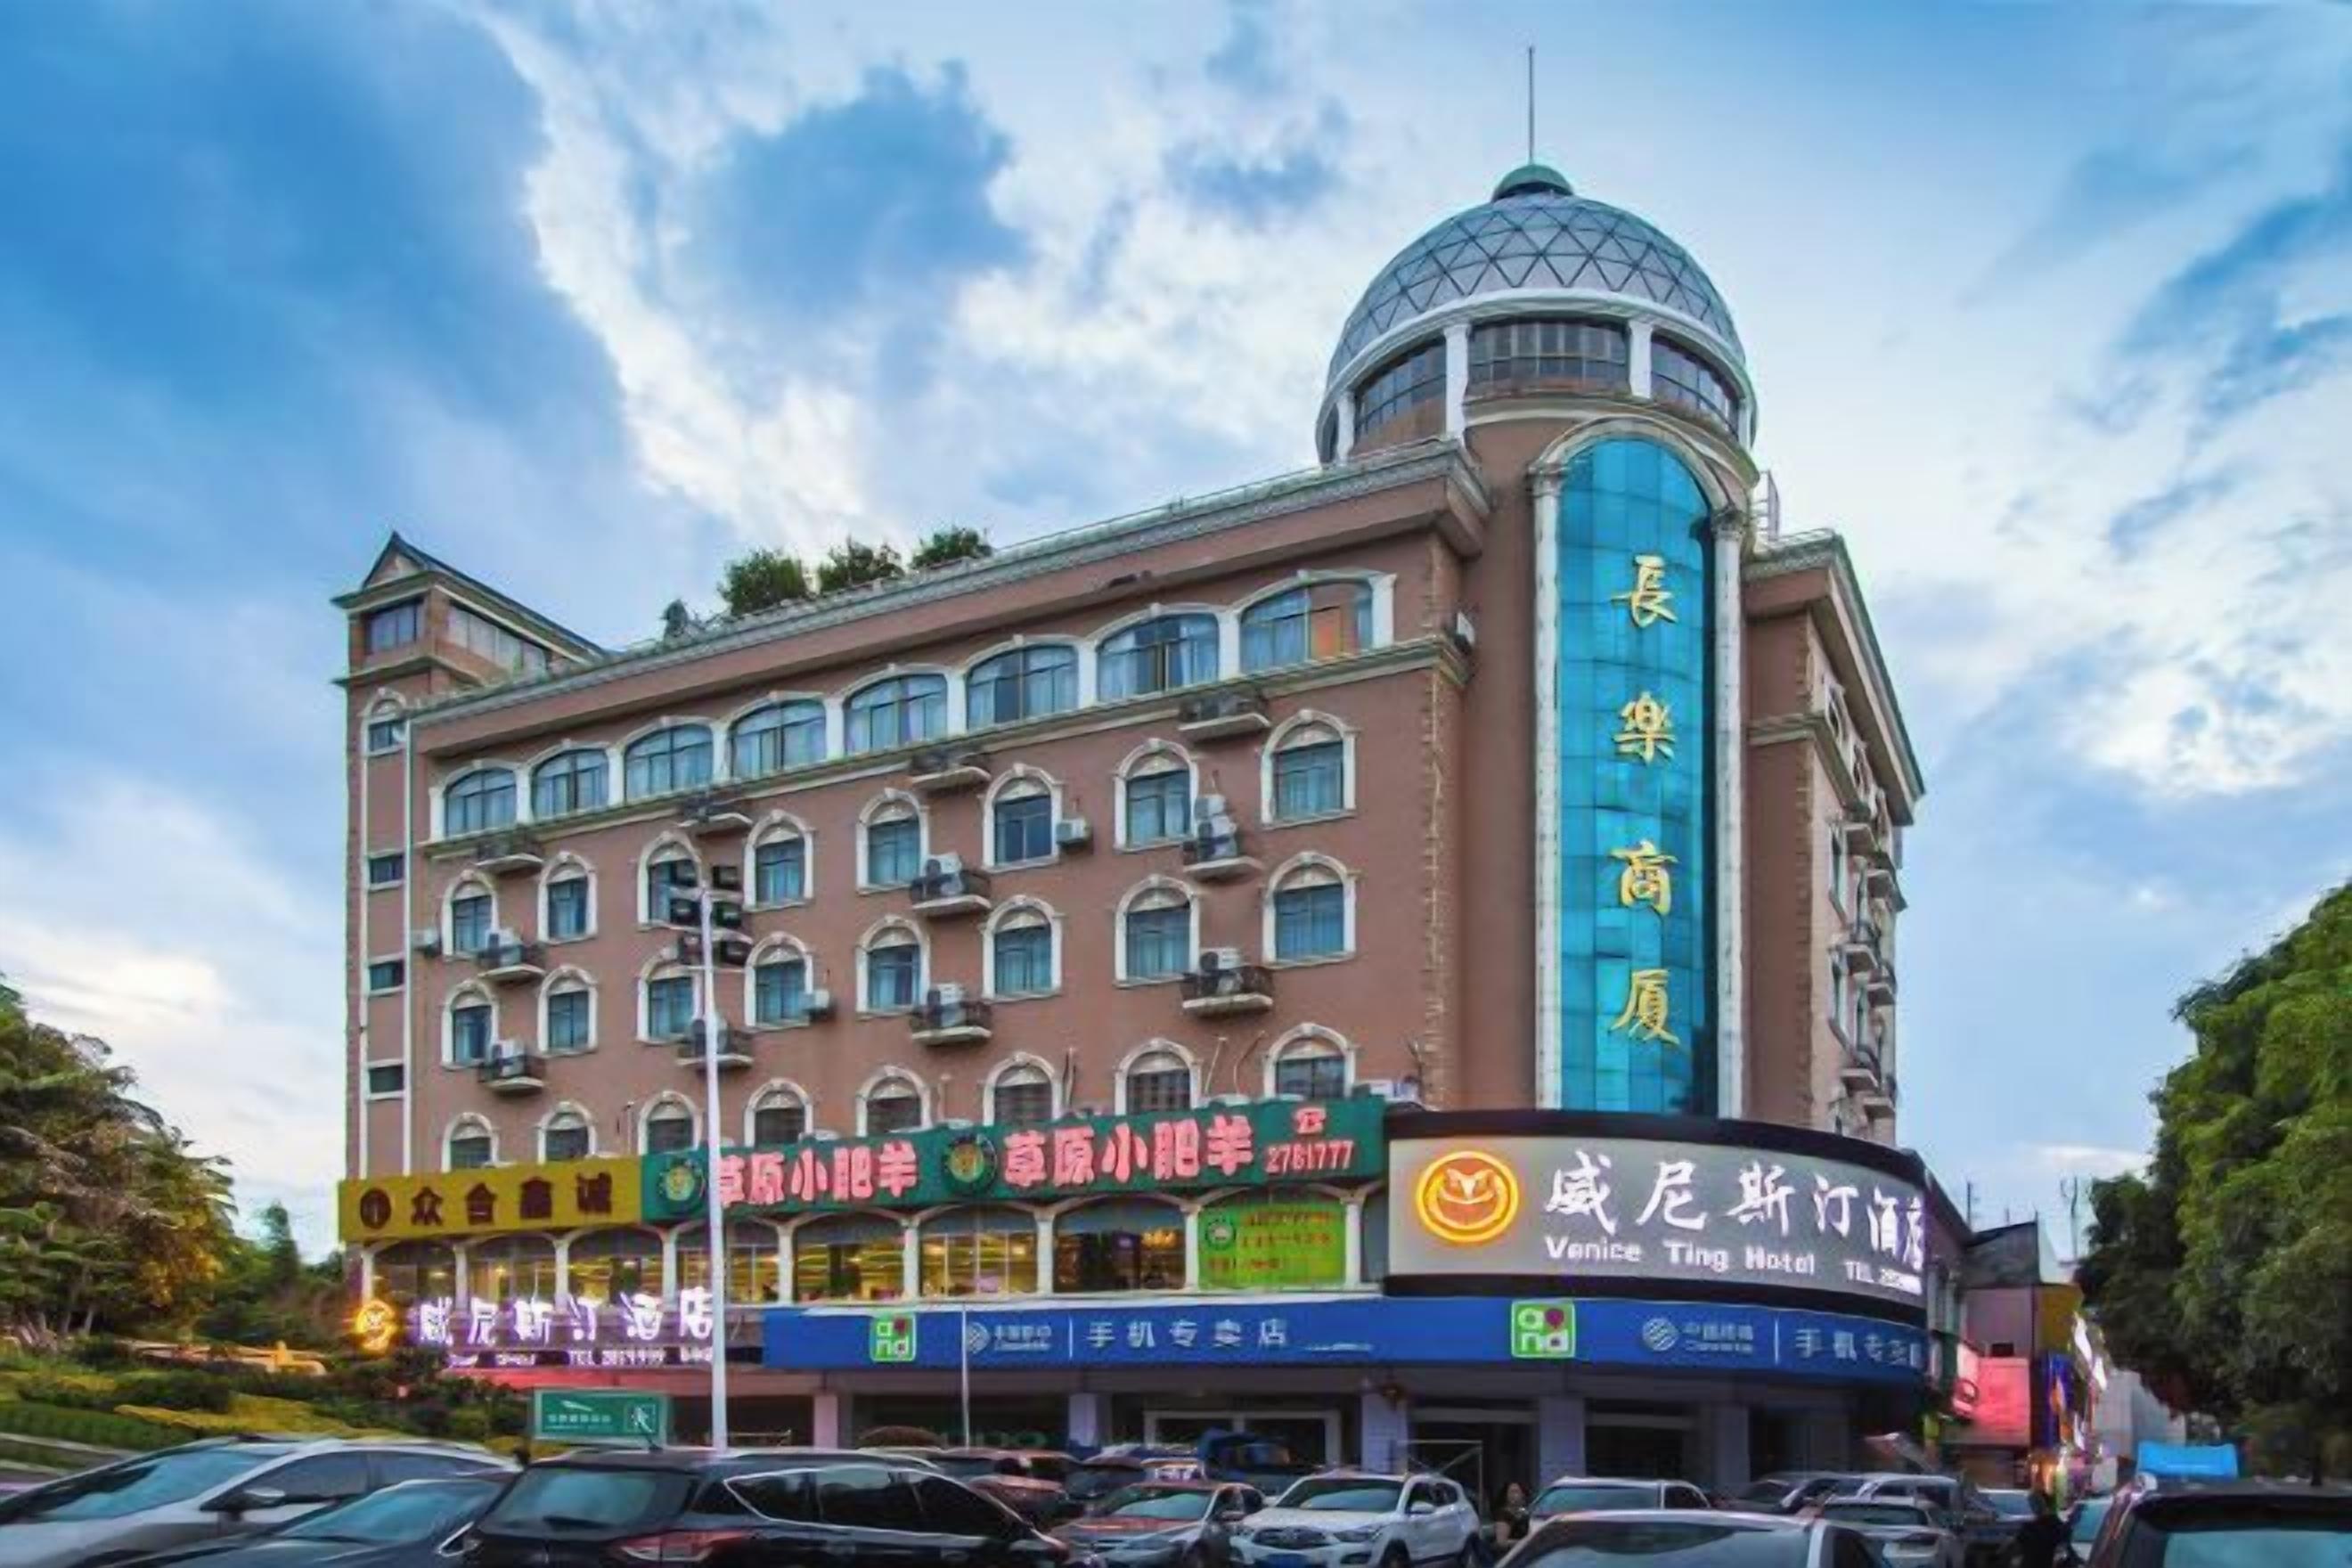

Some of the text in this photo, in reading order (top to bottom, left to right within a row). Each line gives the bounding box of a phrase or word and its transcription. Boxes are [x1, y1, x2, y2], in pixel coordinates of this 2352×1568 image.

[1003, 1115, 1254, 1188] 草原小肥羊
[1545, 1236, 1642, 1262] Venice
[1662, 1238, 1729, 1272] Ting
[1744, 1245, 1816, 1275] Hotel
